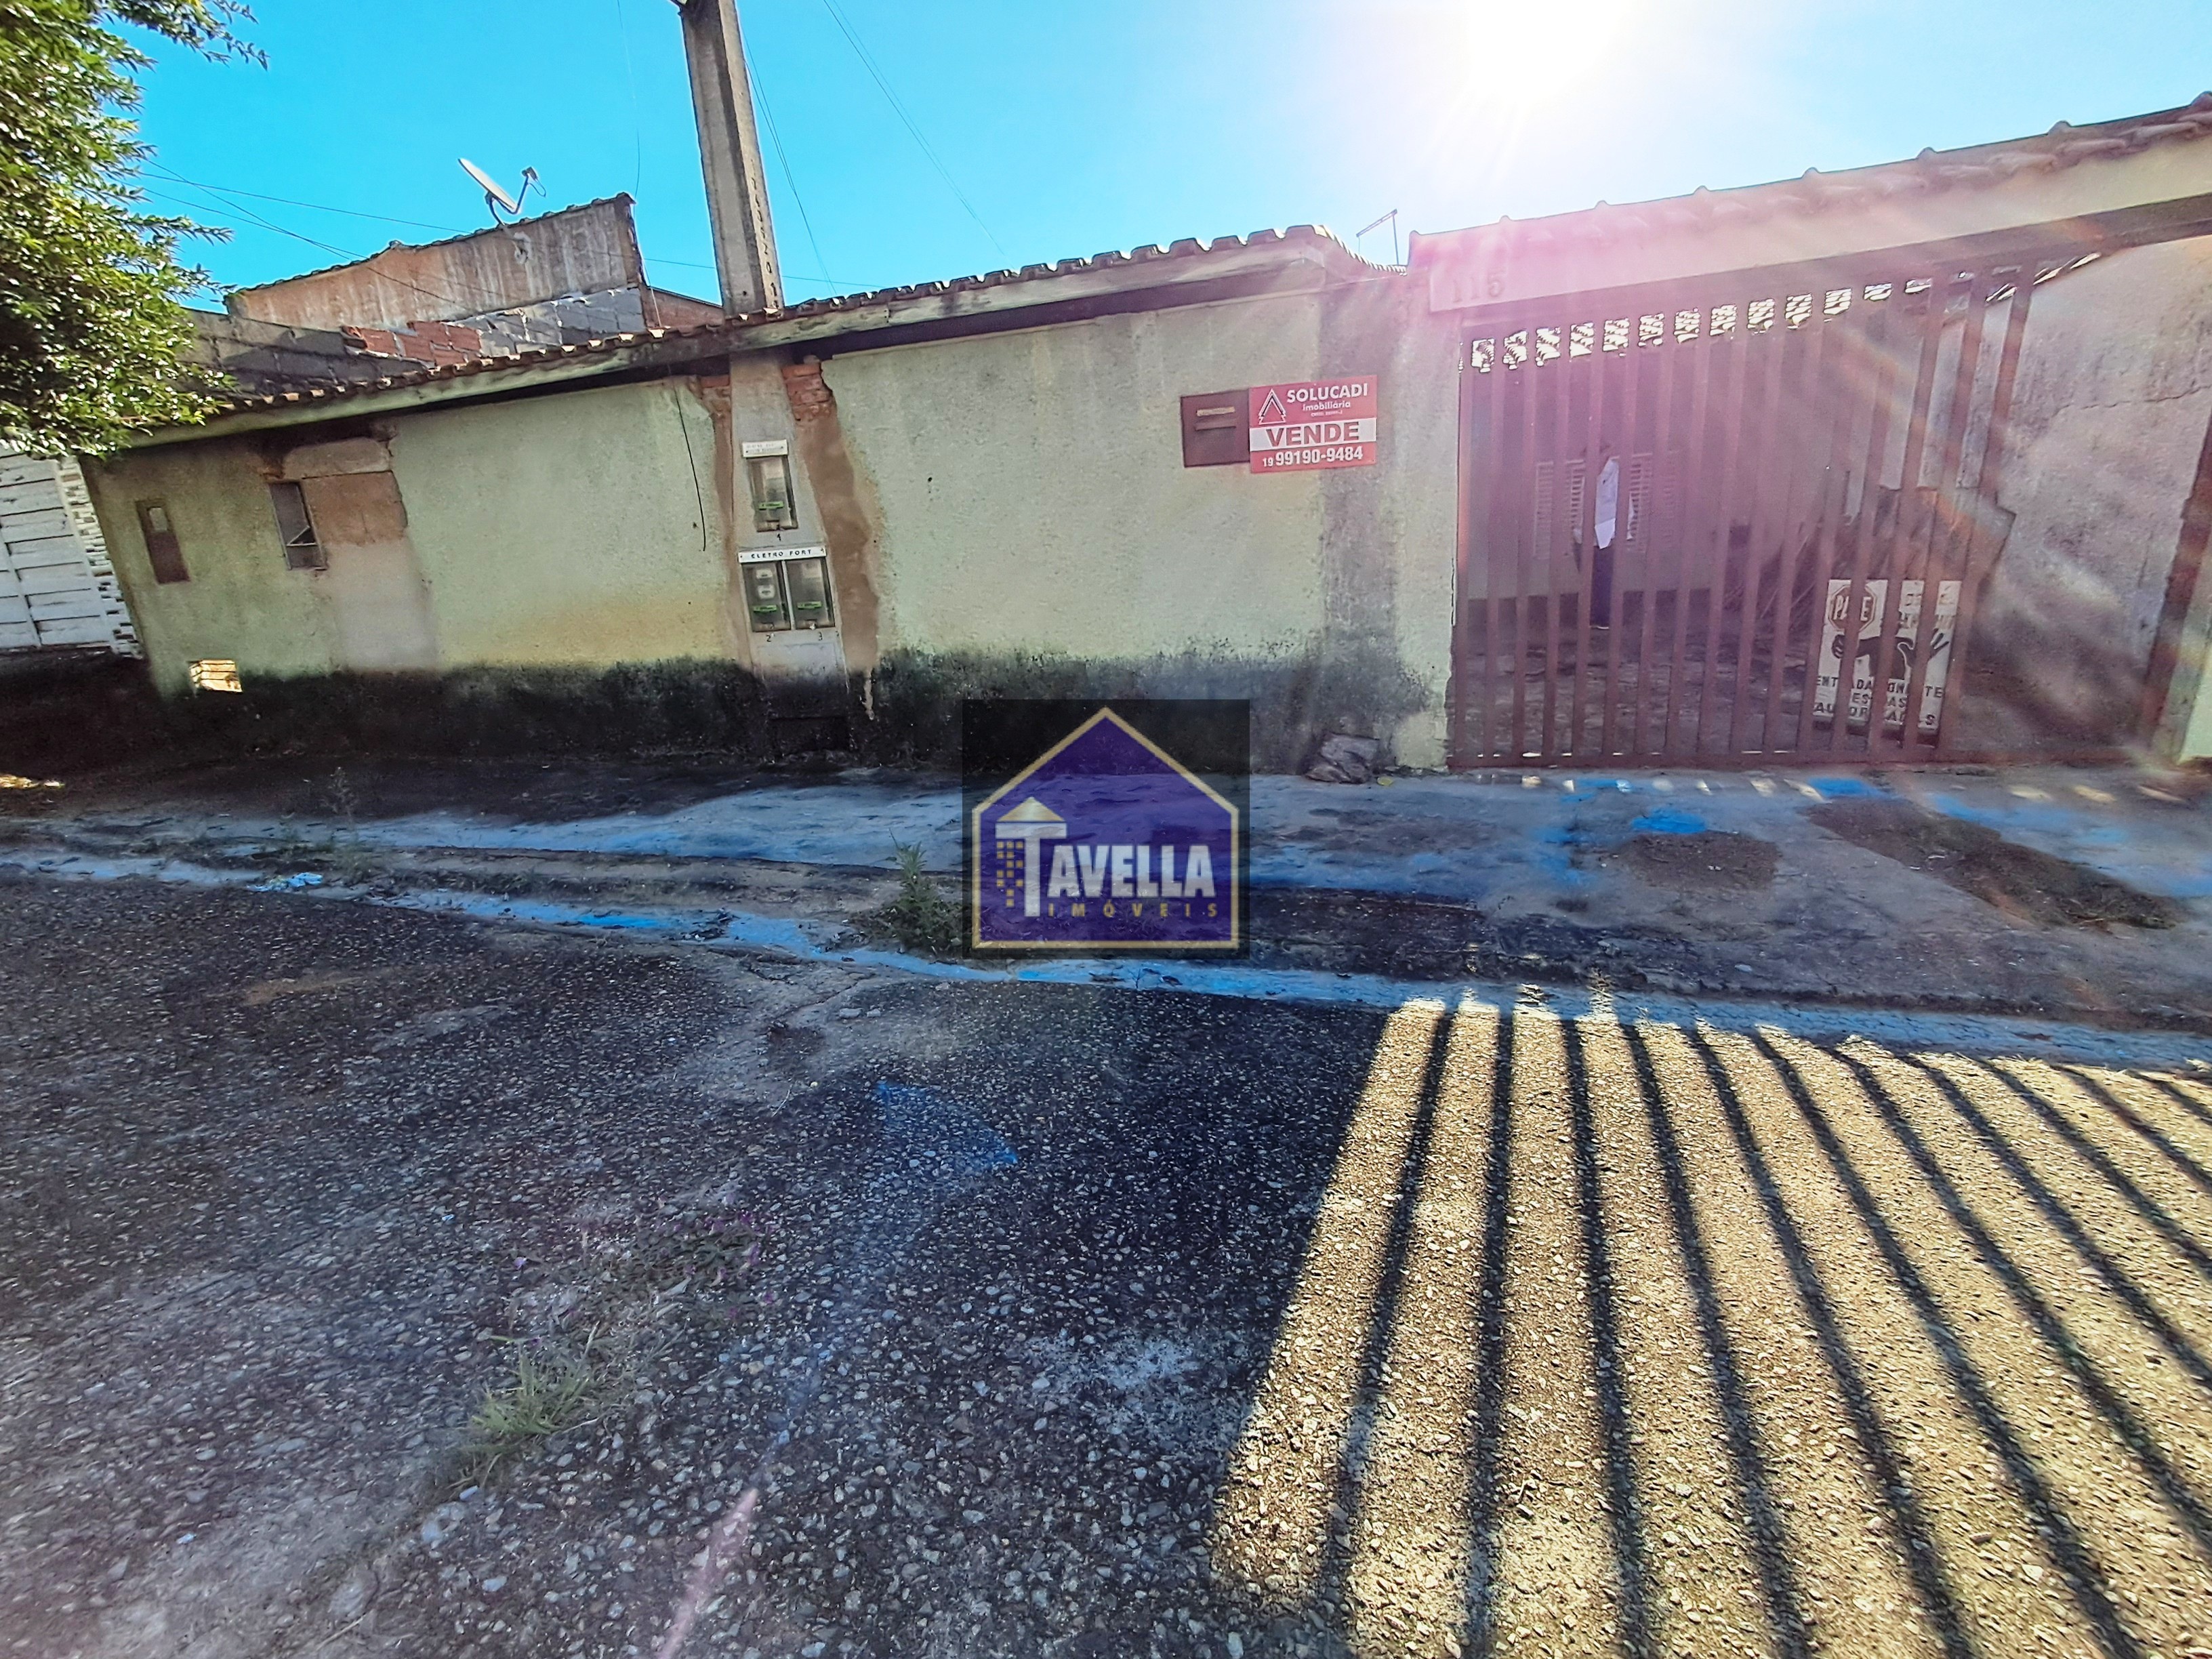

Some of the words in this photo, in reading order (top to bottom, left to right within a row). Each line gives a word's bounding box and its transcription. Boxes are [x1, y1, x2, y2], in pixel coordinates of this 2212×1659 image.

[1287, 383, 1368, 403] SOLUCADI
[1303, 401, 1351, 411] imobiliária
[1266, 422, 1359, 447] VENDE
[1263, 457, 1274, 467] 19
[1275, 446, 1364, 466] 99190-9484
[1816, 676, 1872, 690] ENTDA
[1880, 680, 1944, 699] OMTE
[1845, 693, 1907, 708] ESAS
